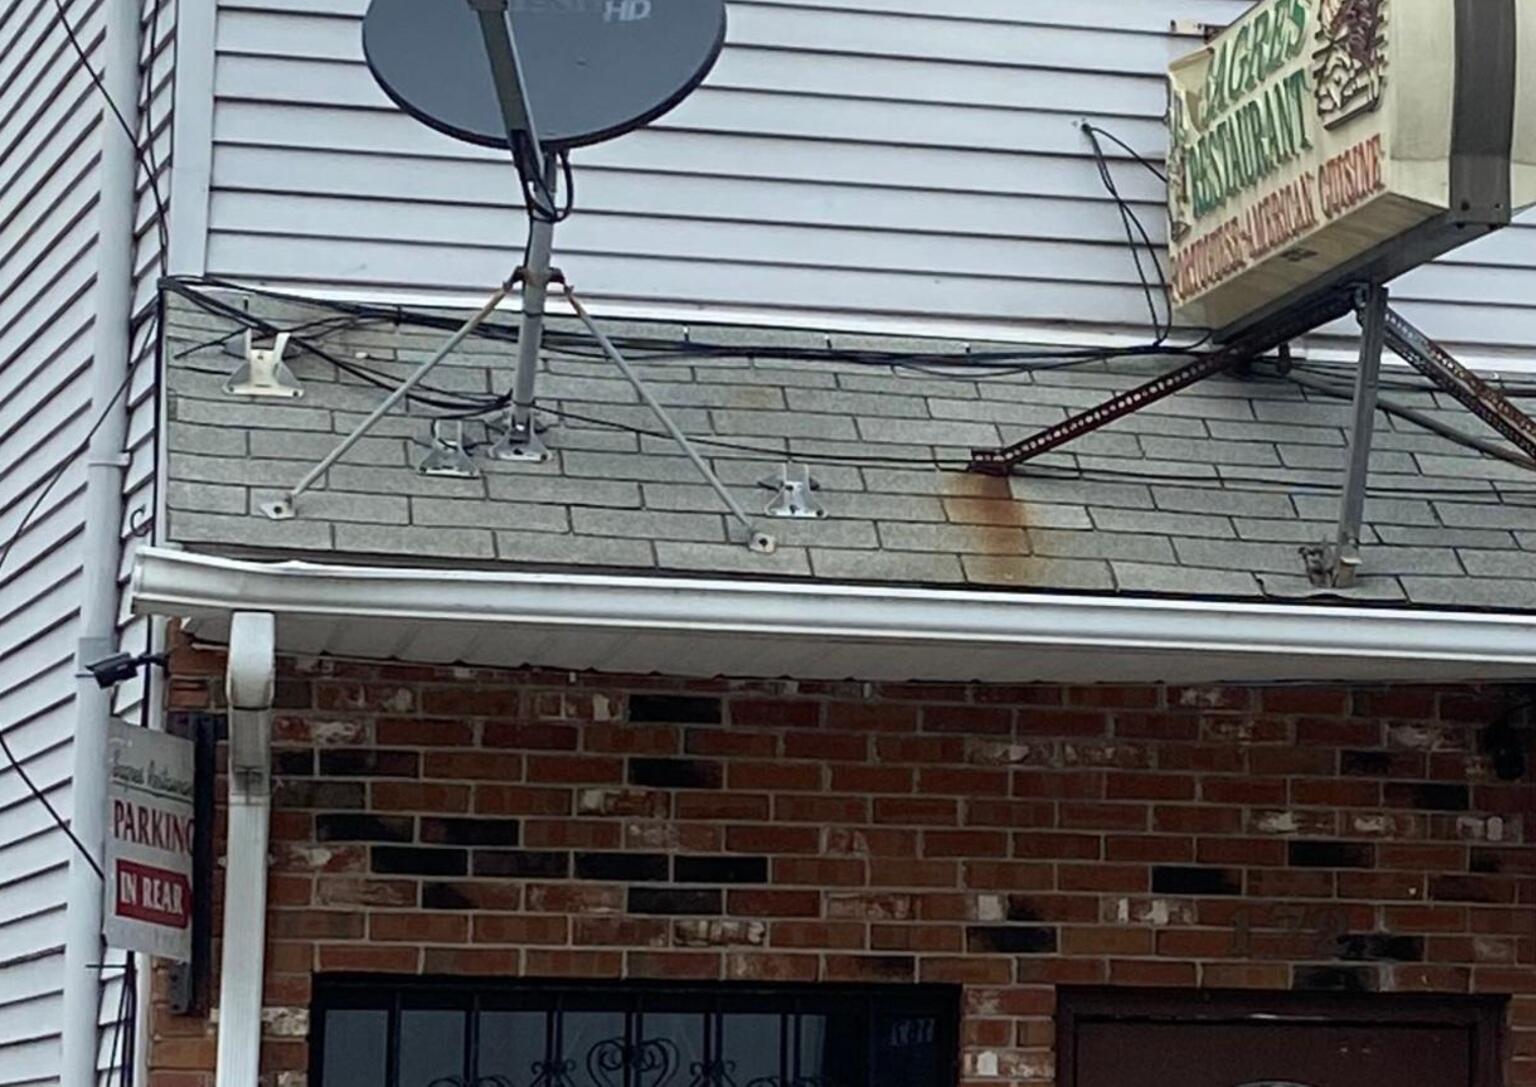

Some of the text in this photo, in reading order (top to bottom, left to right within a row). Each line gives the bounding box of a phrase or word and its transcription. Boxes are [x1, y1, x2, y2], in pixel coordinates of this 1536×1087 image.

[1188, 68, 1313, 219] RESTAURANT
[120, 870, 183, 914] IN REAR
